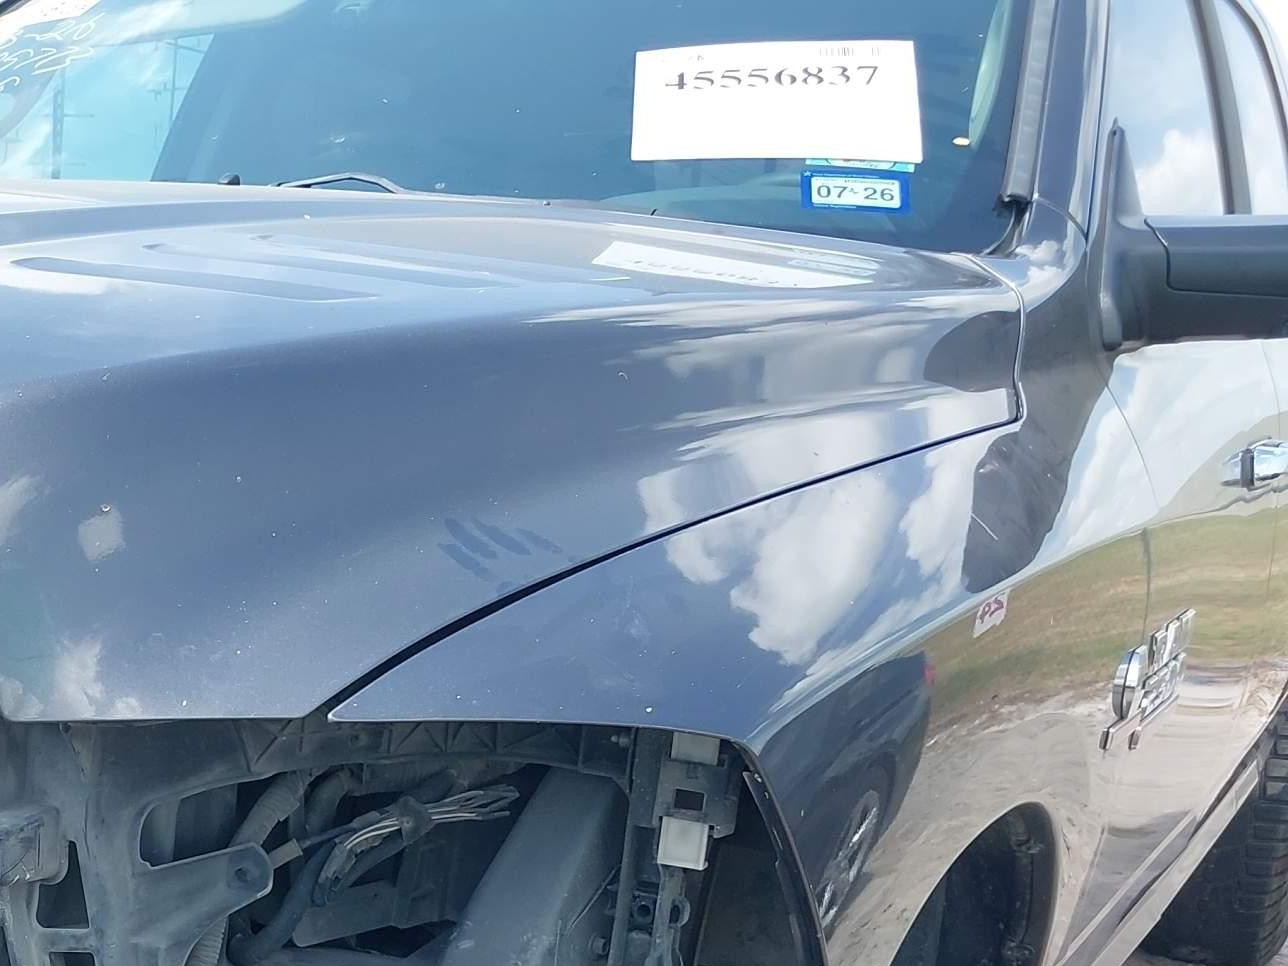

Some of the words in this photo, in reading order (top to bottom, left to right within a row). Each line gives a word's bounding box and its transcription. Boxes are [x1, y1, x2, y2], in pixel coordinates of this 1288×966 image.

[664, 65, 880, 91] 45556837
[817, 185, 848, 199] 07
[863, 187, 895, 202] 26
